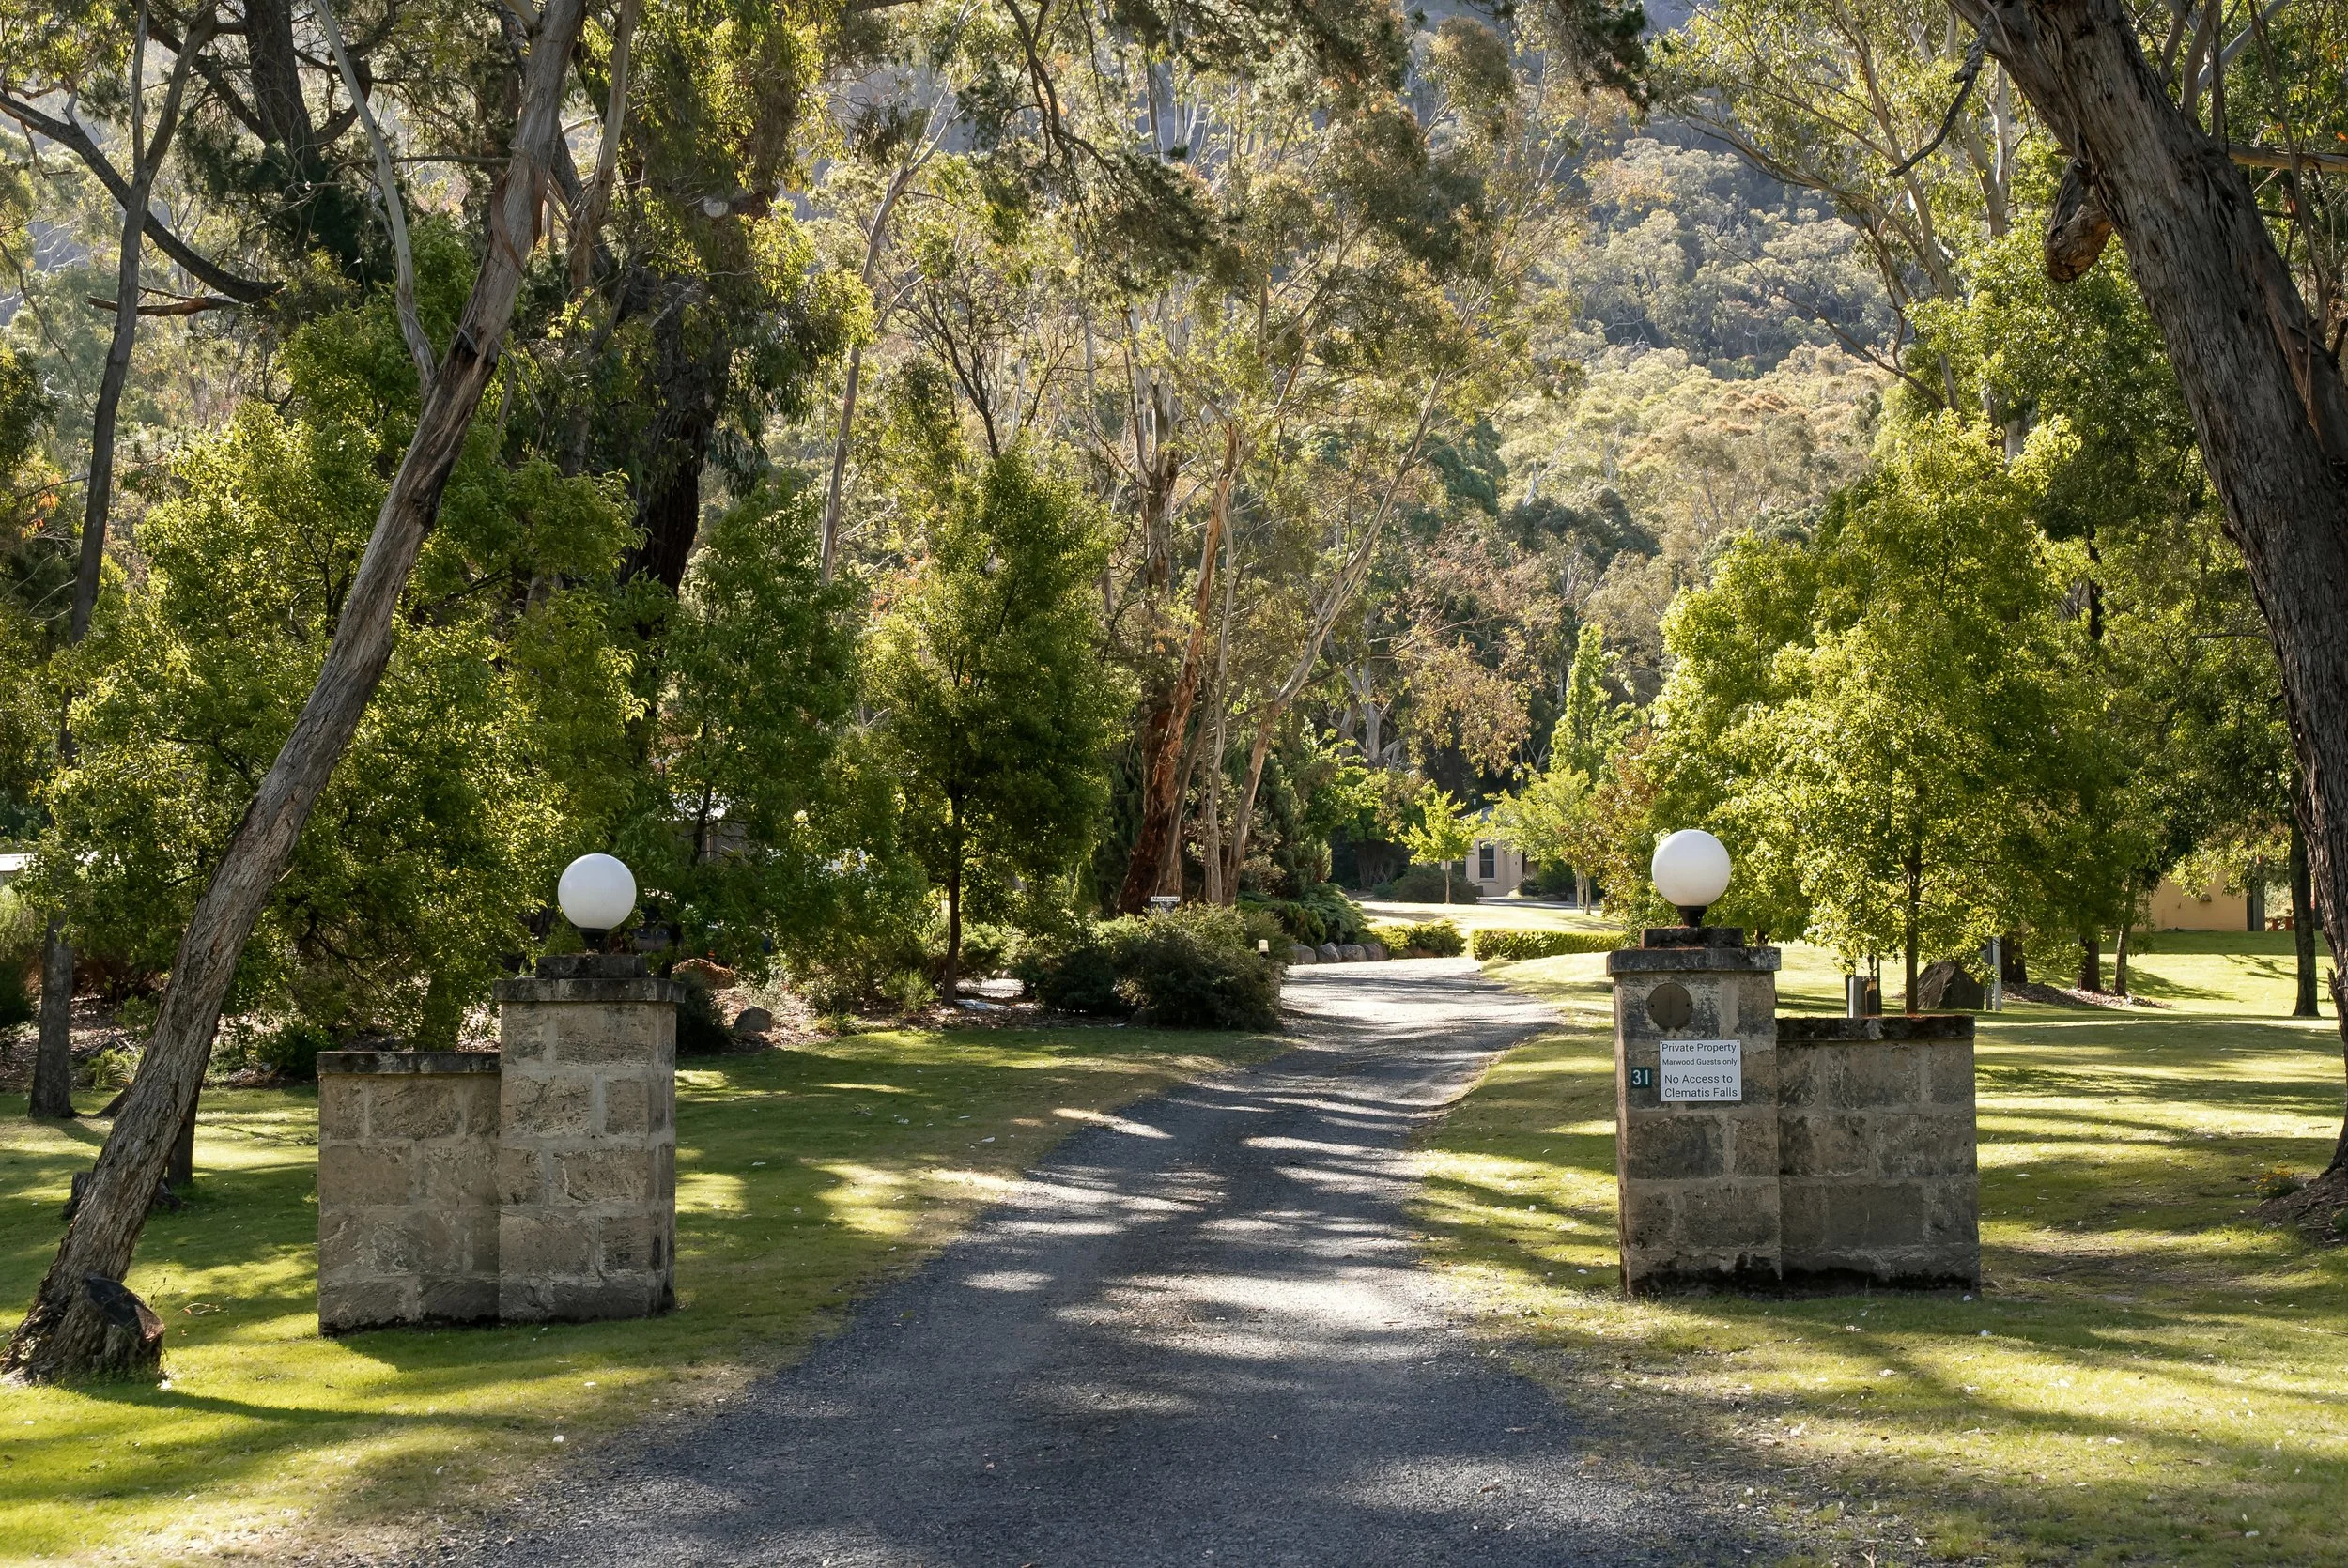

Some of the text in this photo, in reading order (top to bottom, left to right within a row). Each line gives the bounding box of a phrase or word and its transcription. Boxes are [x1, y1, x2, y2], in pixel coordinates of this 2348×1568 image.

[1661, 1043, 1737, 1053] Private Property
[1722, 1058, 1738, 1067] only
[1632, 1069, 1648, 1085] 31
[1664, 1075, 1733, 1084] No Access to
[1664, 1087, 1738, 1097] Clematis Falls
